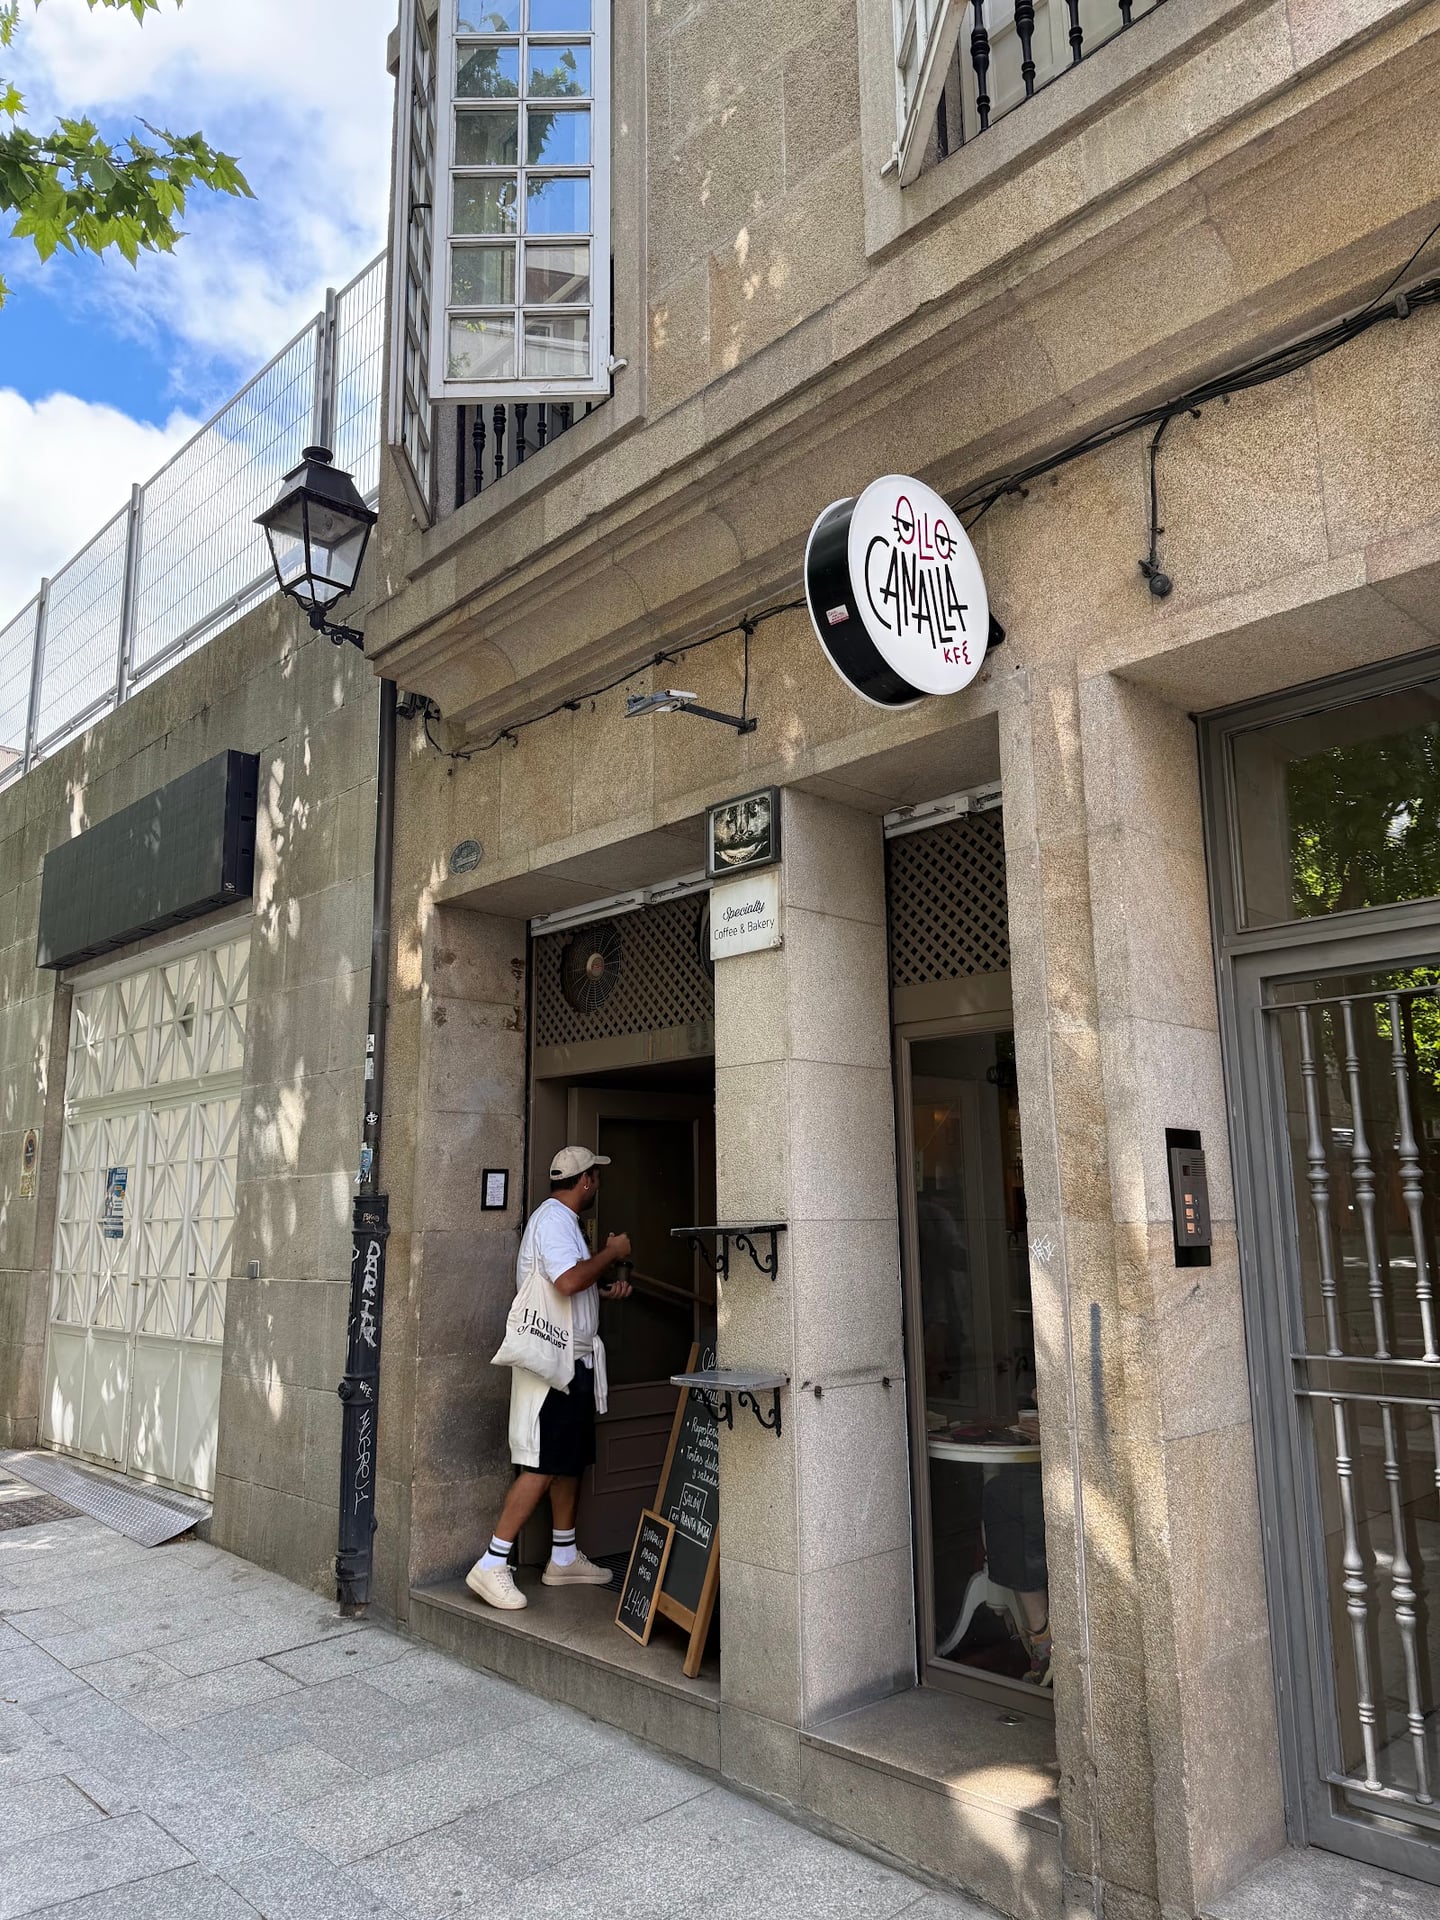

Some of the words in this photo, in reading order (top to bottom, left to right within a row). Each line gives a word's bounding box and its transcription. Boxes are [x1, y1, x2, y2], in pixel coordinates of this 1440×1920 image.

[892, 496, 957, 561] OLLO
[865, 536, 968, 649] CANALLA
[723, 900, 765, 922] Specialty
[713, 926, 738, 941] Coffee
[739, 923, 746, 934] &
[747, 918, 775, 933] Bakery
[517, 1324, 530, 1336] of
[530, 1327, 567, 1351] ERIKALUST
[523, 1308, 569, 1343] House
